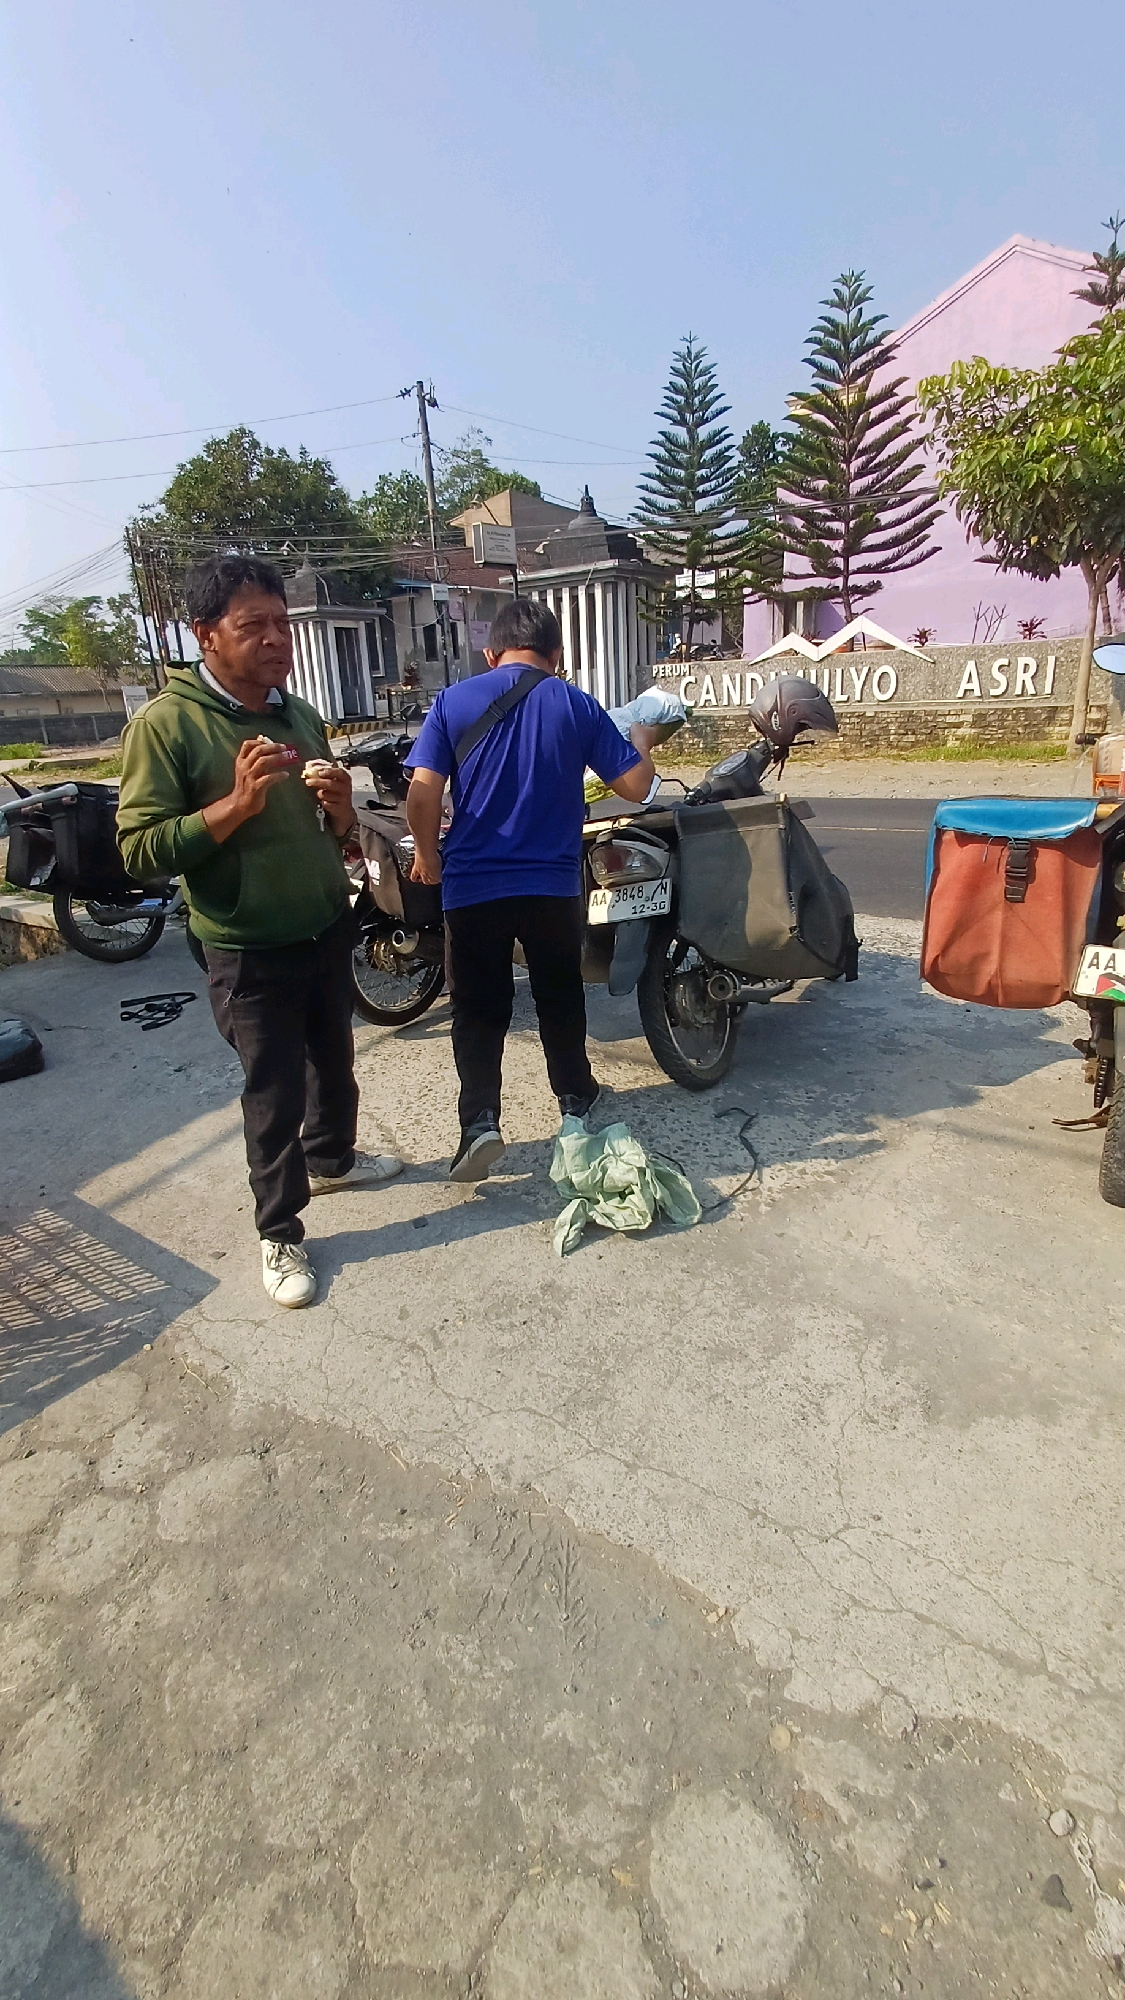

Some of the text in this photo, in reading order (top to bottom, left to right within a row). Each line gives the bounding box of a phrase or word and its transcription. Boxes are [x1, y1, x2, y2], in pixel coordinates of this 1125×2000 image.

[652, 664, 691, 678] PERUM
[956, 655, 1056, 699] ASRI
[591, 881, 668, 907] AA 3848 N
[1087, 951, 1117, 972] AA
